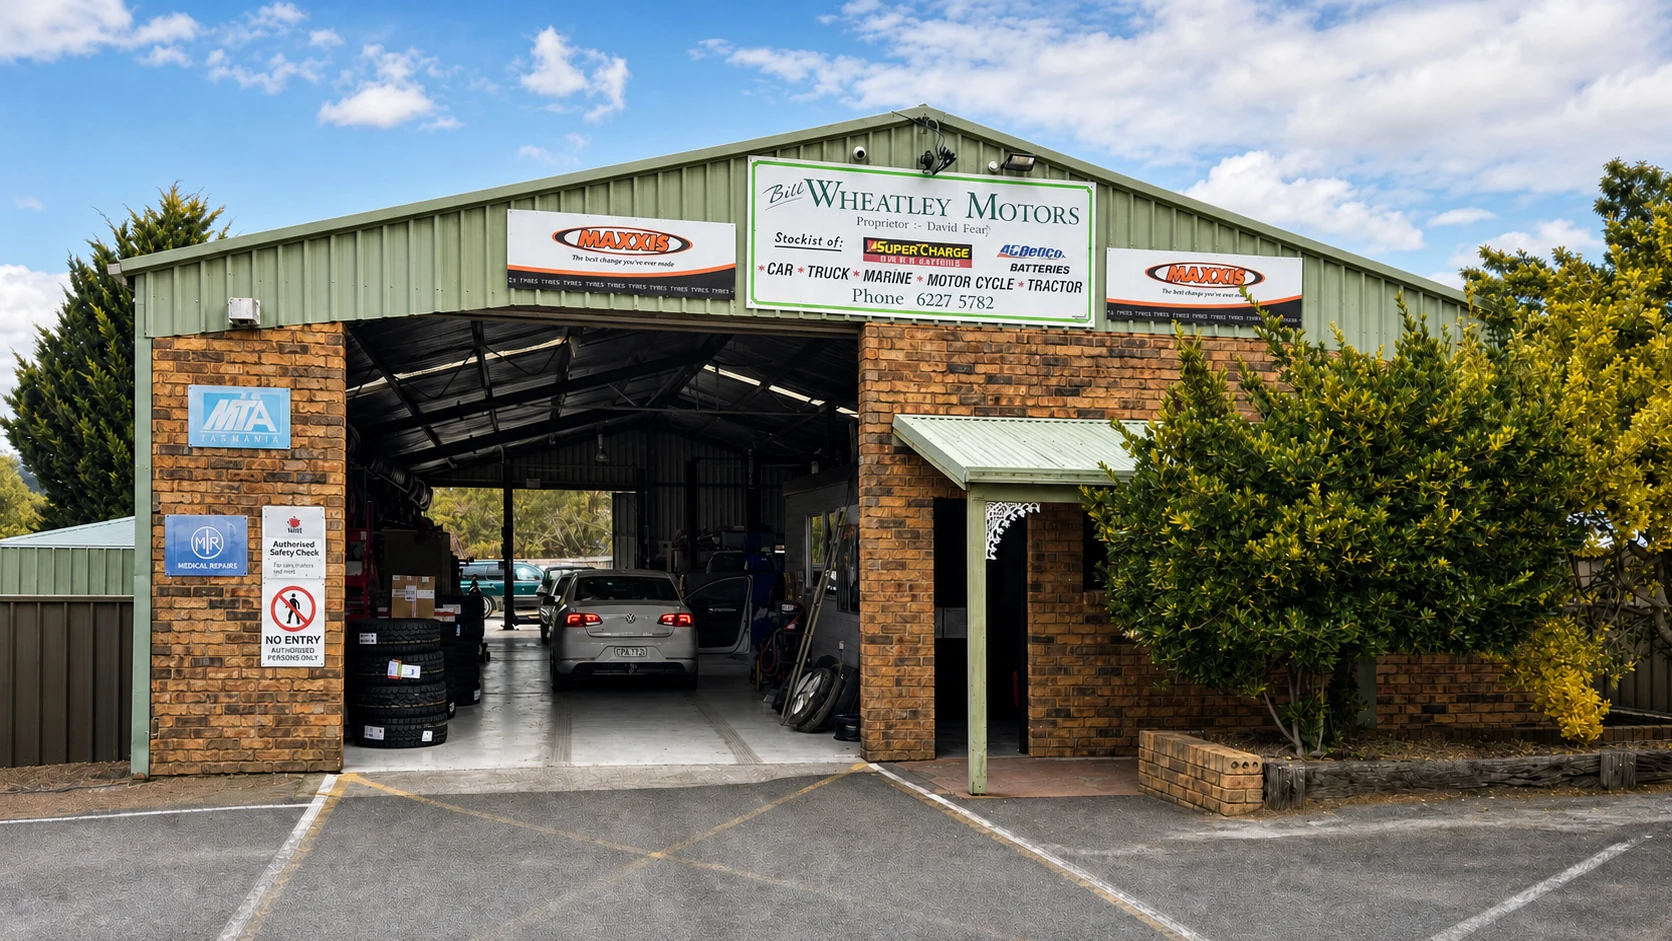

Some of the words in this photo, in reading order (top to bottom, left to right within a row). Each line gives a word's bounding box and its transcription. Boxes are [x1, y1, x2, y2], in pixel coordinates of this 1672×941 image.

[763, 181, 805, 204] Bill
[803, 178, 952, 217] WHEATLEY
[965, 191, 1080, 225] MOTORS
[856, 216, 910, 230] Proprietor
[927, 221, 958, 233] David
[577, 229, 671, 253] MAXXIS
[774, 231, 823, 246] Stockist
[827, 235, 844, 248] of:
[599, 257, 622, 265] change
[1009, 263, 1071, 275] BATTERIES
[767, 261, 794, 277] CAR
[807, 265, 851, 280] TRUCK
[863, 269, 913, 285] MARINE
[926, 273, 972, 289] MOTOR
[975, 277, 1016, 291] CYCLE
[1027, 278, 1083, 294] TRACTOR
[1166, 264, 1246, 286] MAXXIS
[852, 288, 904, 305] Phone
[916, 292, 952, 308] 6227
[958, 294, 995, 310] 5782
[202, 399, 277, 432] MTA
[201, 434, 279, 443] TASMANIA
[270, 549, 295, 557] Safety
[265, 635, 282, 644] NO
[284, 635, 321, 644] ENTRY
